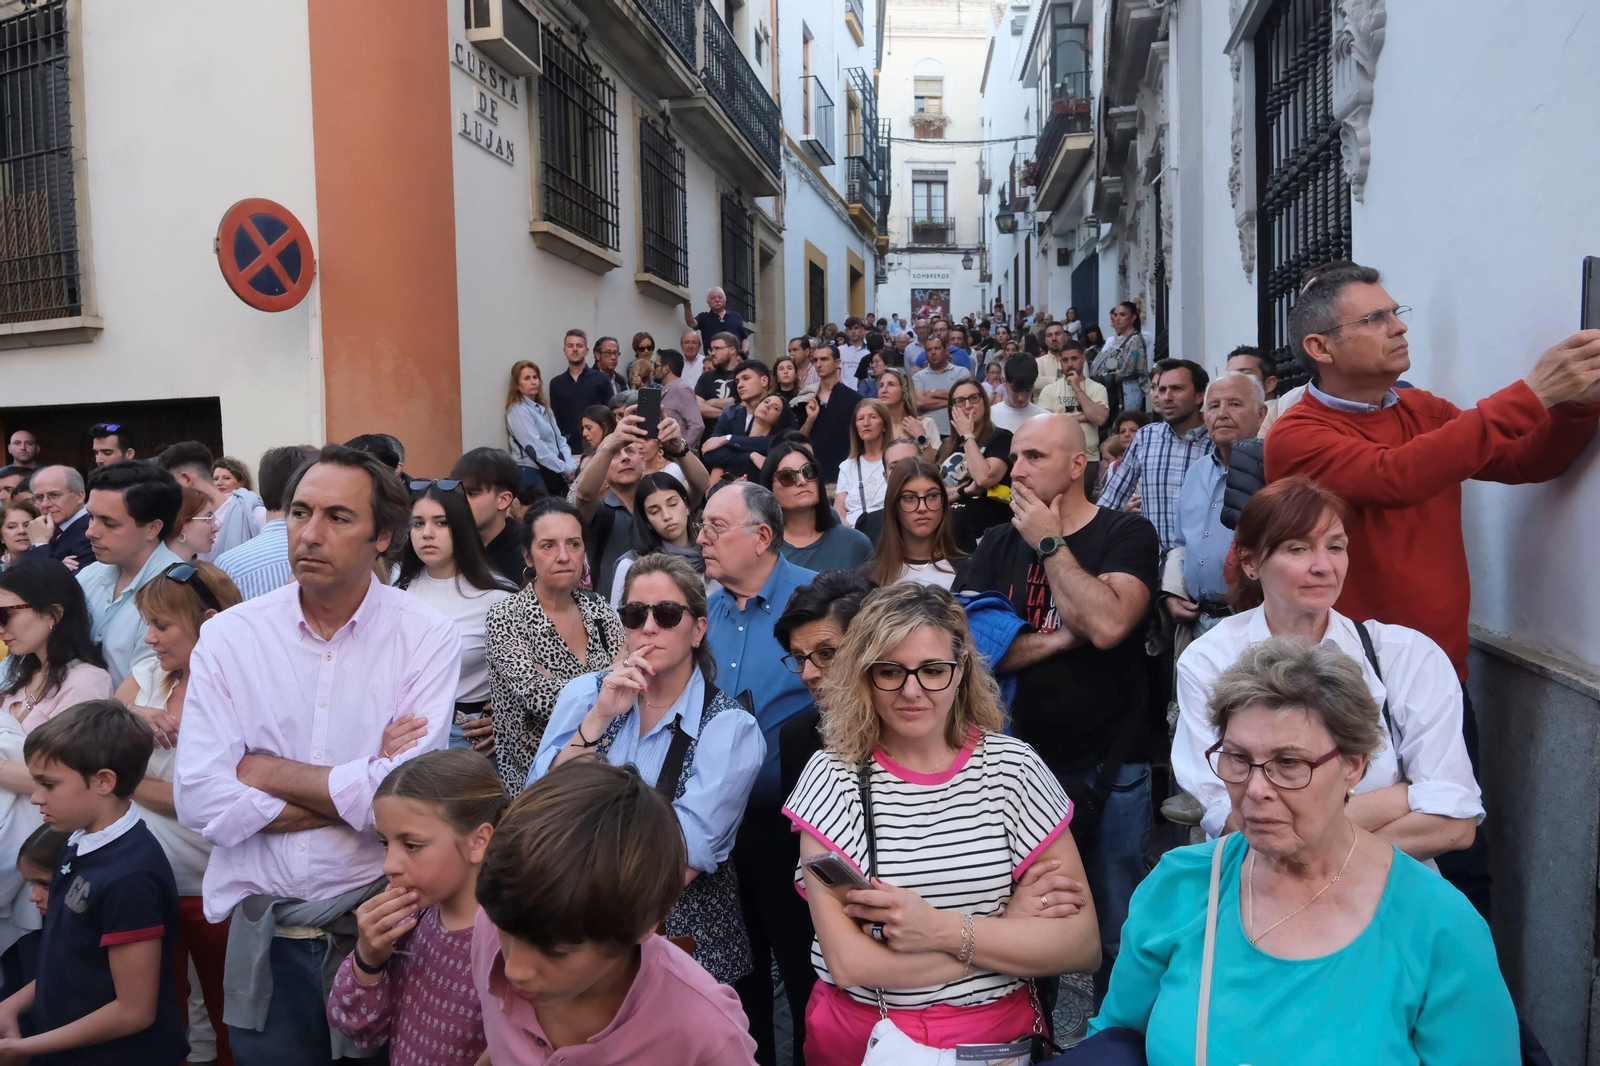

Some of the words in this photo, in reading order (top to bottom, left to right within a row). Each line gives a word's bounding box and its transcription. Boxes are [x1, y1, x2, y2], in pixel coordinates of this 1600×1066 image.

[455, 42, 519, 104] CUESTA
[479, 91, 498, 122] DE
[462, 112, 514, 162] LUJAN
